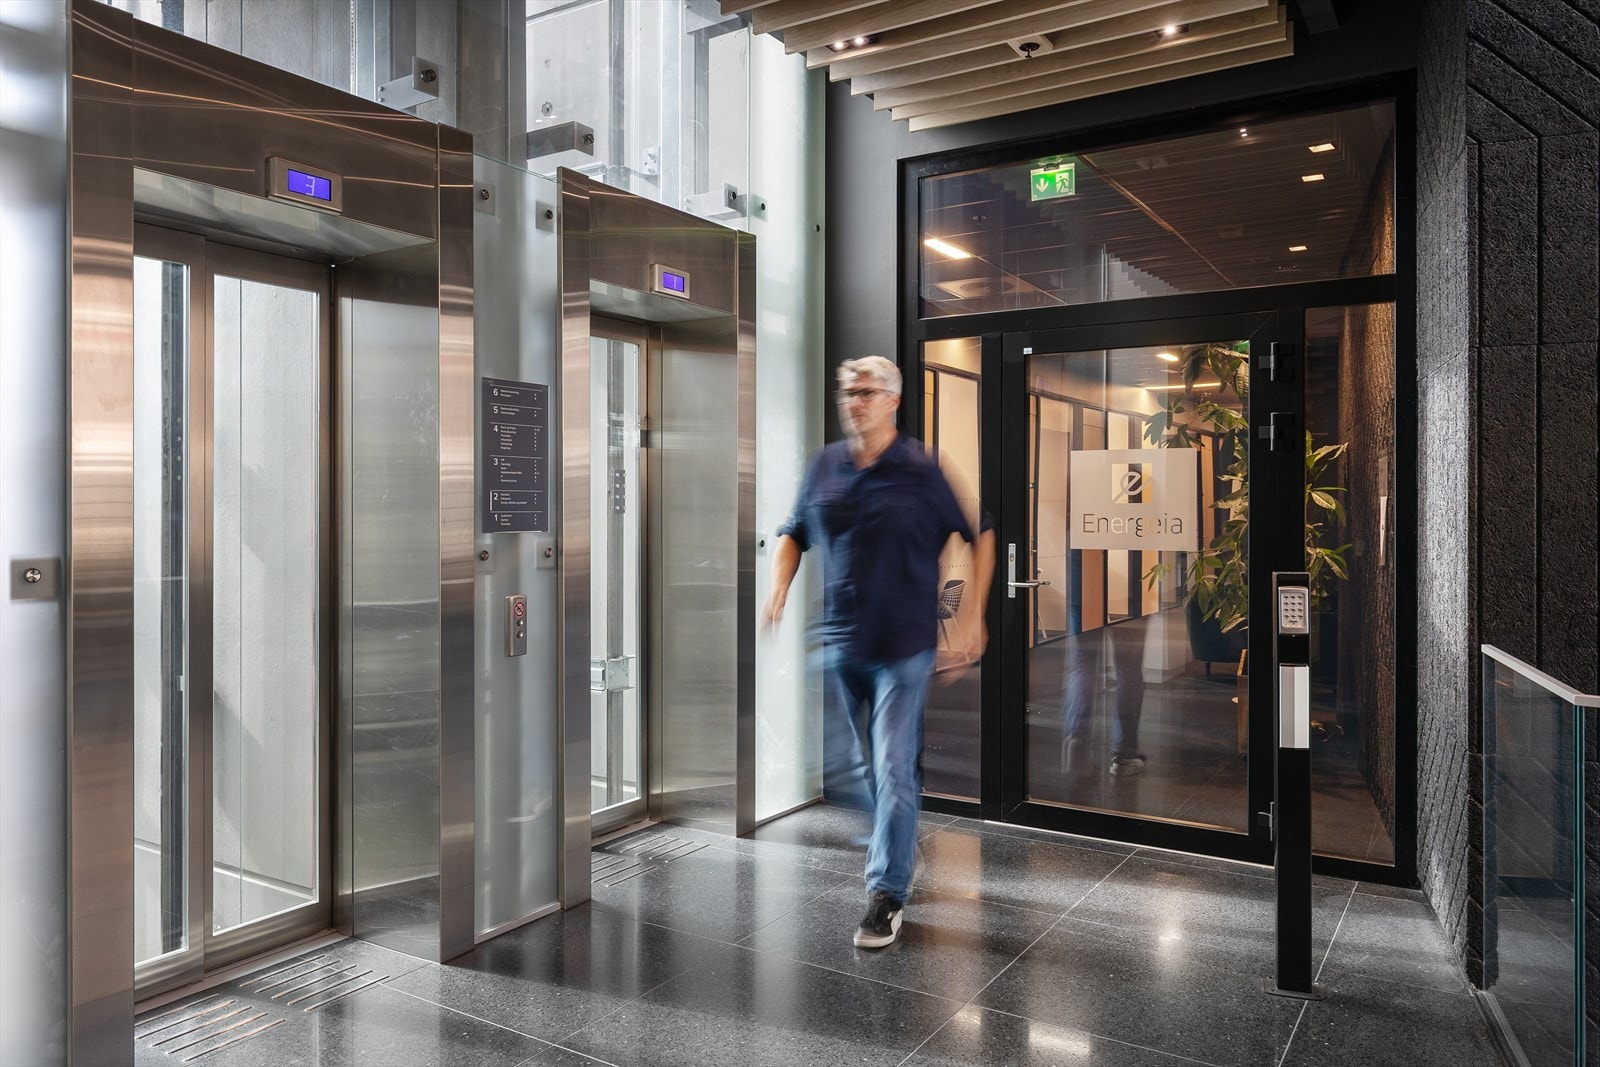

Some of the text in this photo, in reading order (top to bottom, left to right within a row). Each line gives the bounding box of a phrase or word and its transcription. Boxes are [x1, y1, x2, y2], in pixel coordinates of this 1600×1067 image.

[305, 175, 316, 196] 3
[493, 388, 499, 396] 6
[493, 406, 499, 414] 5
[493, 424, 499, 432] 4
[493, 457, 499, 466] 3
[493, 492, 499, 500] 2
[494, 513, 498, 521] 1
[1083, 513, 1183, 537] Energeia
